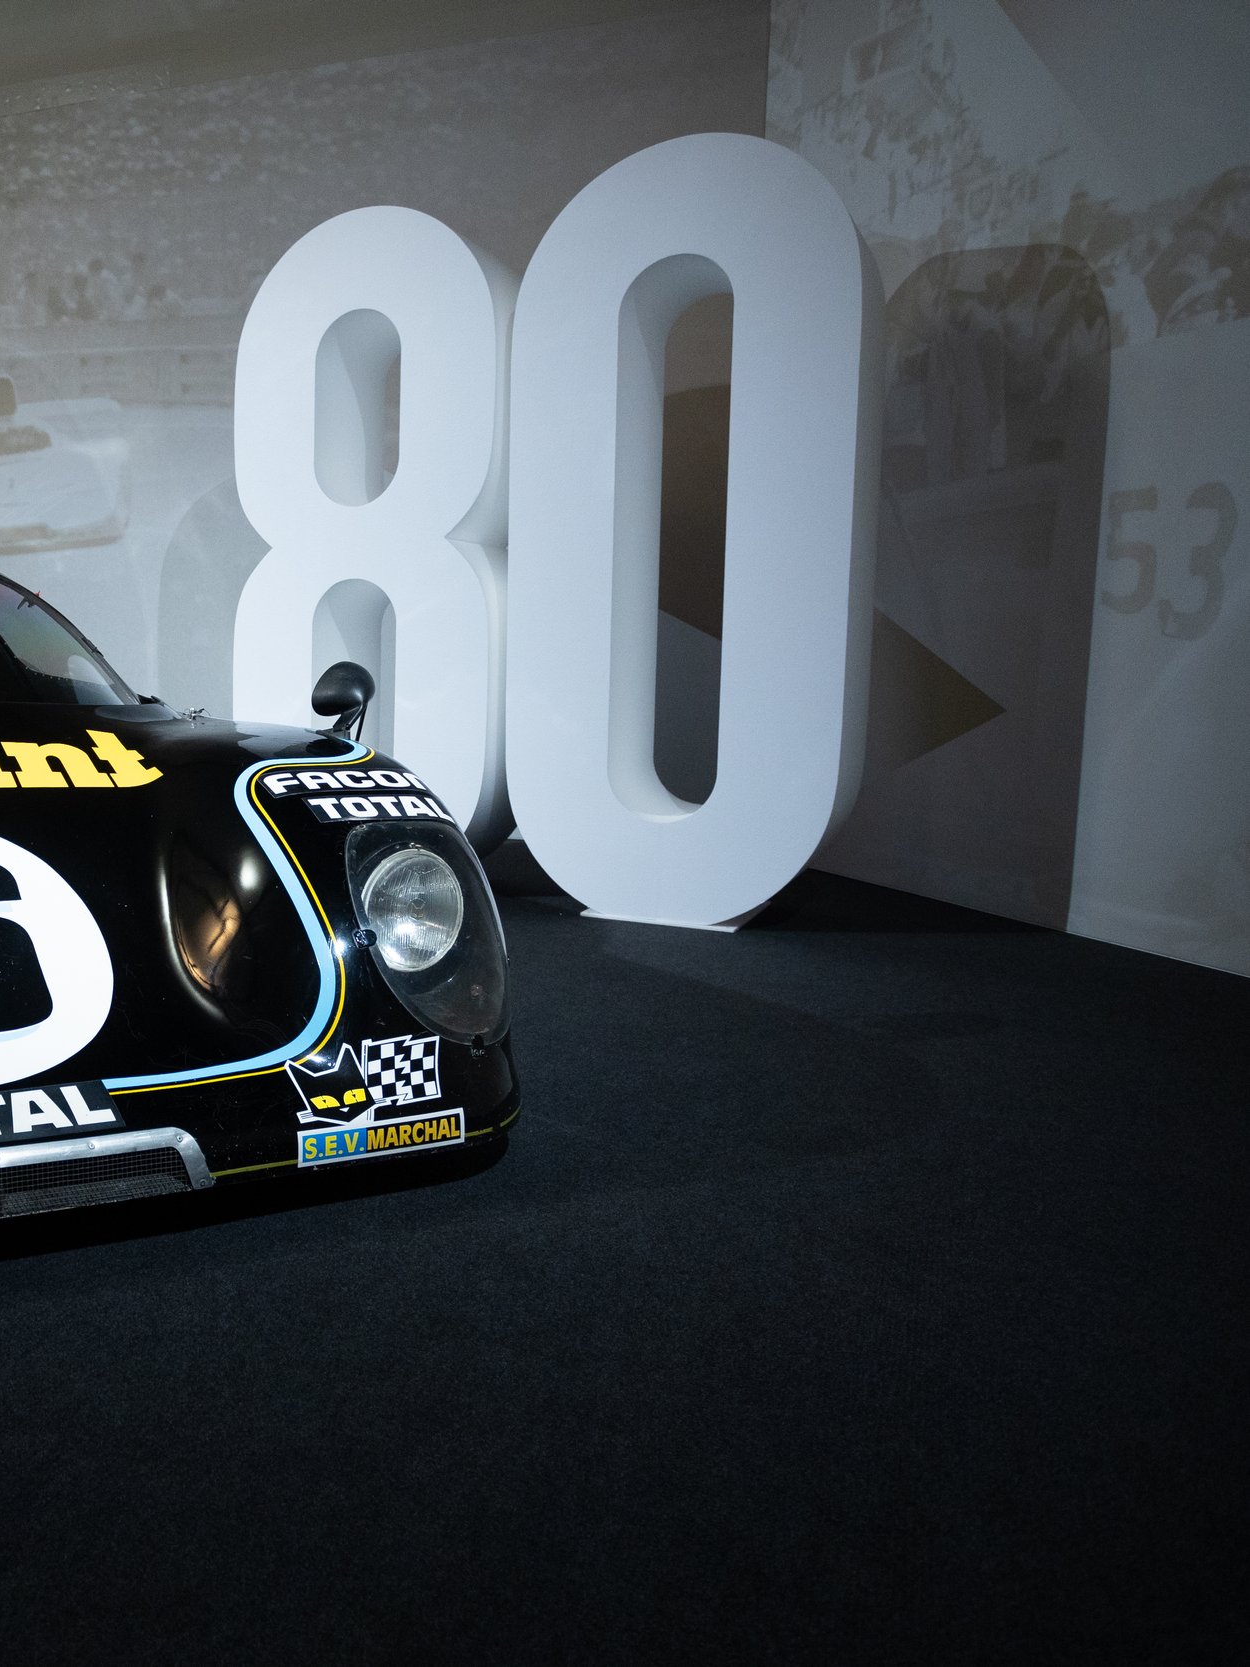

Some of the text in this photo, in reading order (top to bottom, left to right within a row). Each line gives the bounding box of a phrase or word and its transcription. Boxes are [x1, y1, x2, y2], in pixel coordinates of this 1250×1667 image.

[233, 132, 866, 926] 80
[1100, 482, 1237, 641] 53
[367, 1117, 460, 1151] MARCHAL
